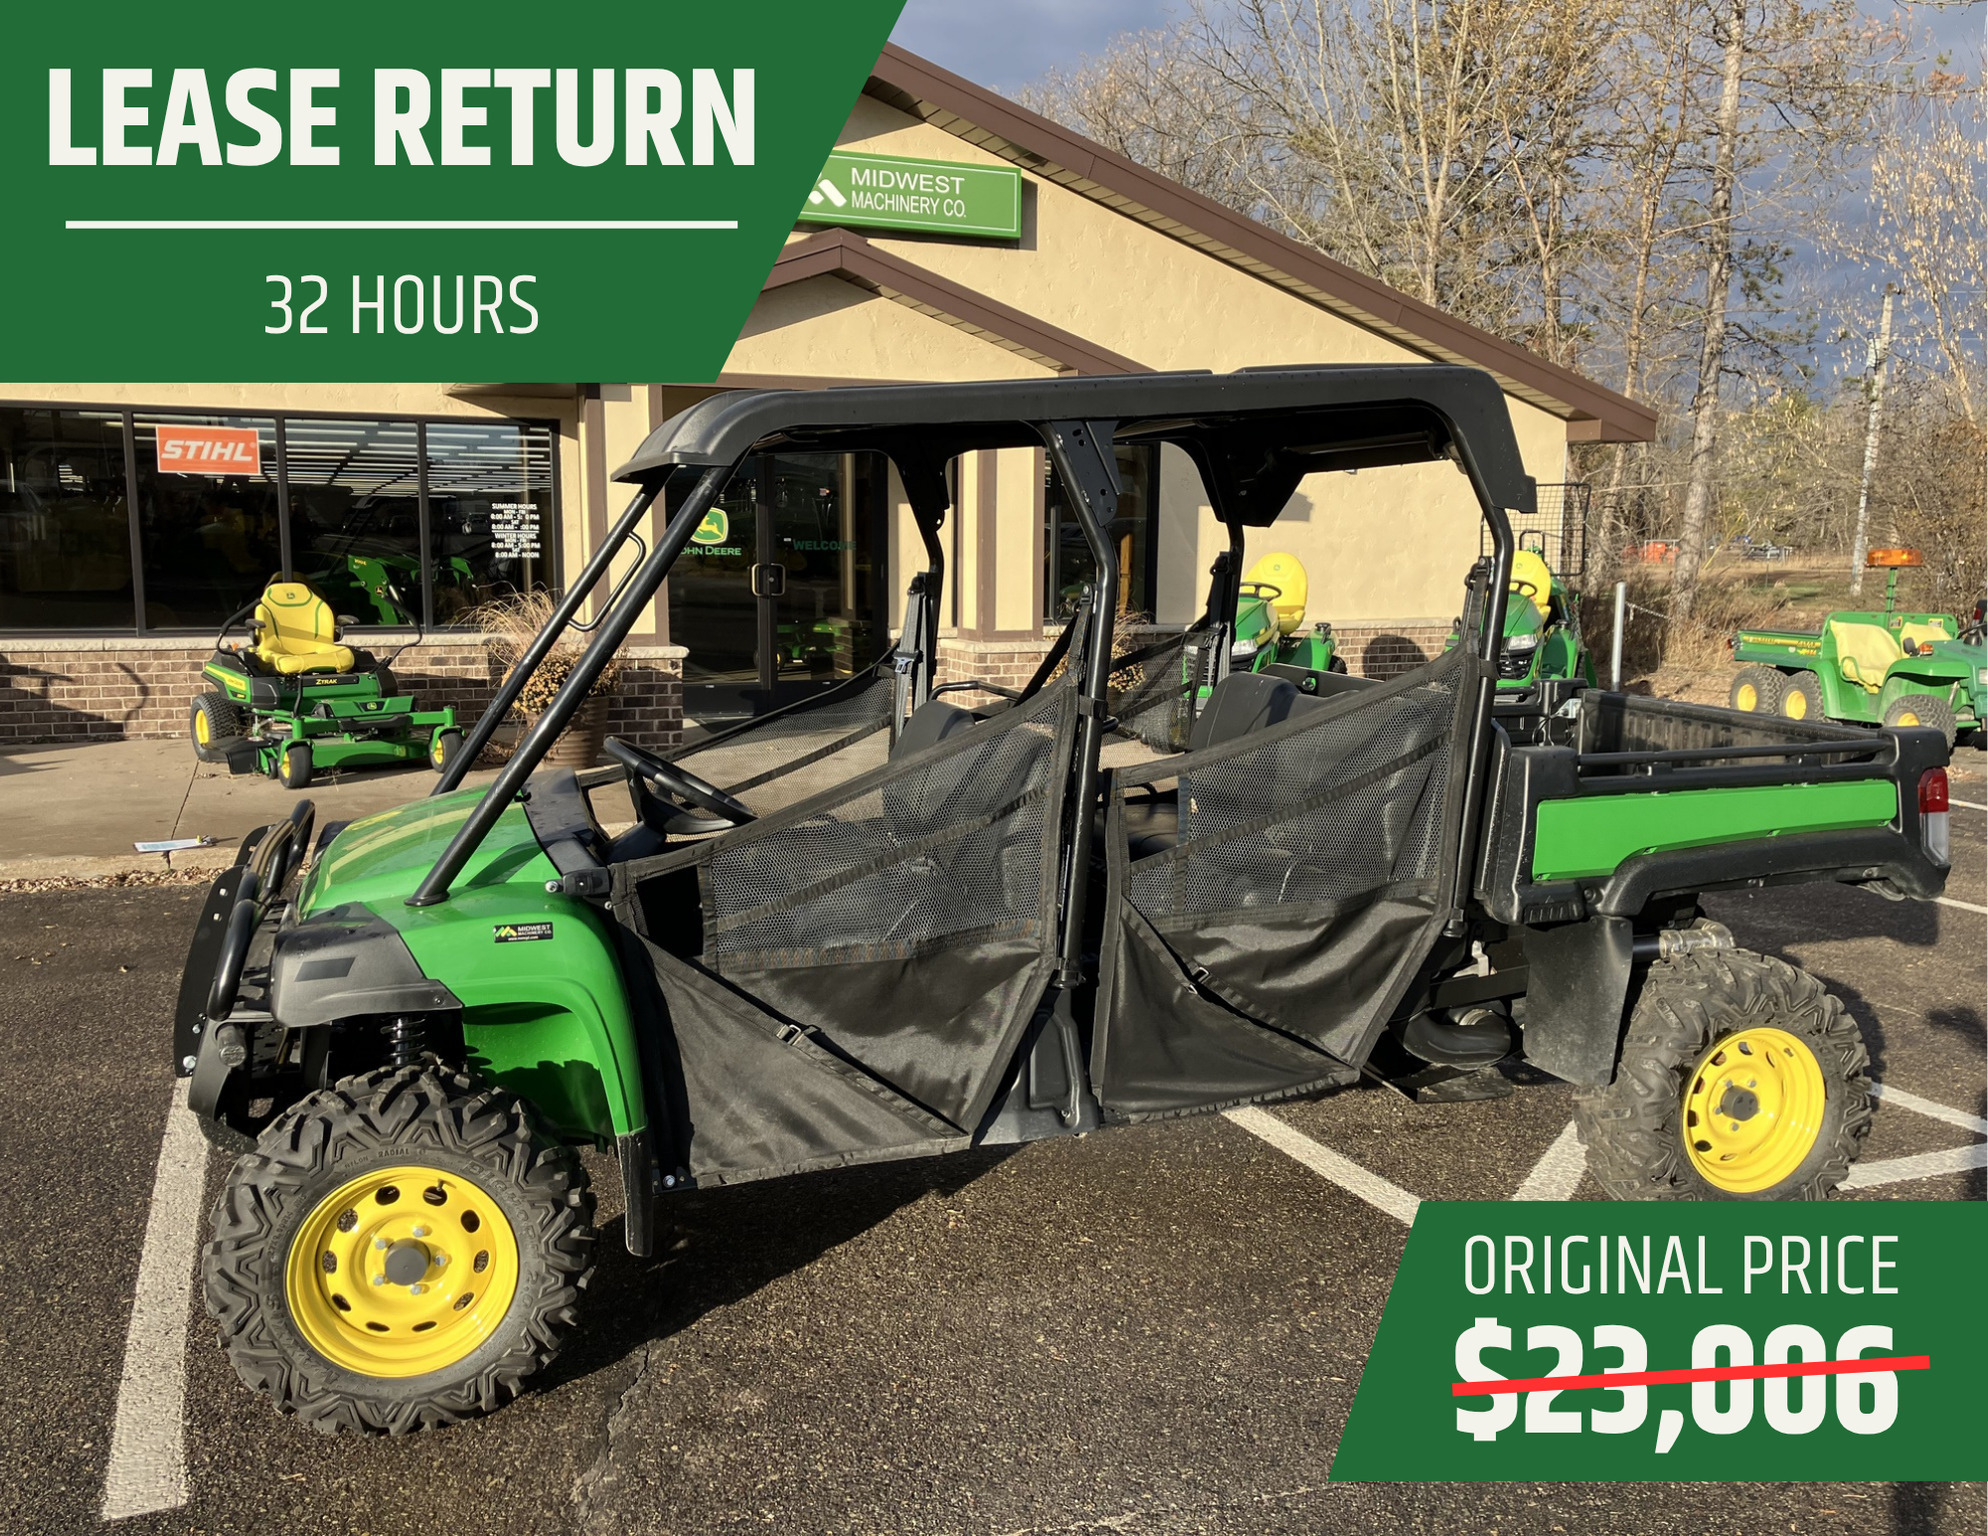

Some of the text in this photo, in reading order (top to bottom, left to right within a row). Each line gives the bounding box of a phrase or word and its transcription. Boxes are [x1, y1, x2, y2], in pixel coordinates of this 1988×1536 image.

[851, 167, 965, 195] MIDWEST
[851, 190, 967, 218] MACHINERY CO.
[161, 439, 253, 462] STIHL
[680, 546, 703, 556] OHN
[793, 540, 856, 551] WELCOME
[517, 924, 551, 932] MIDWEST
[378, 1147, 410, 1158] RADIAL
